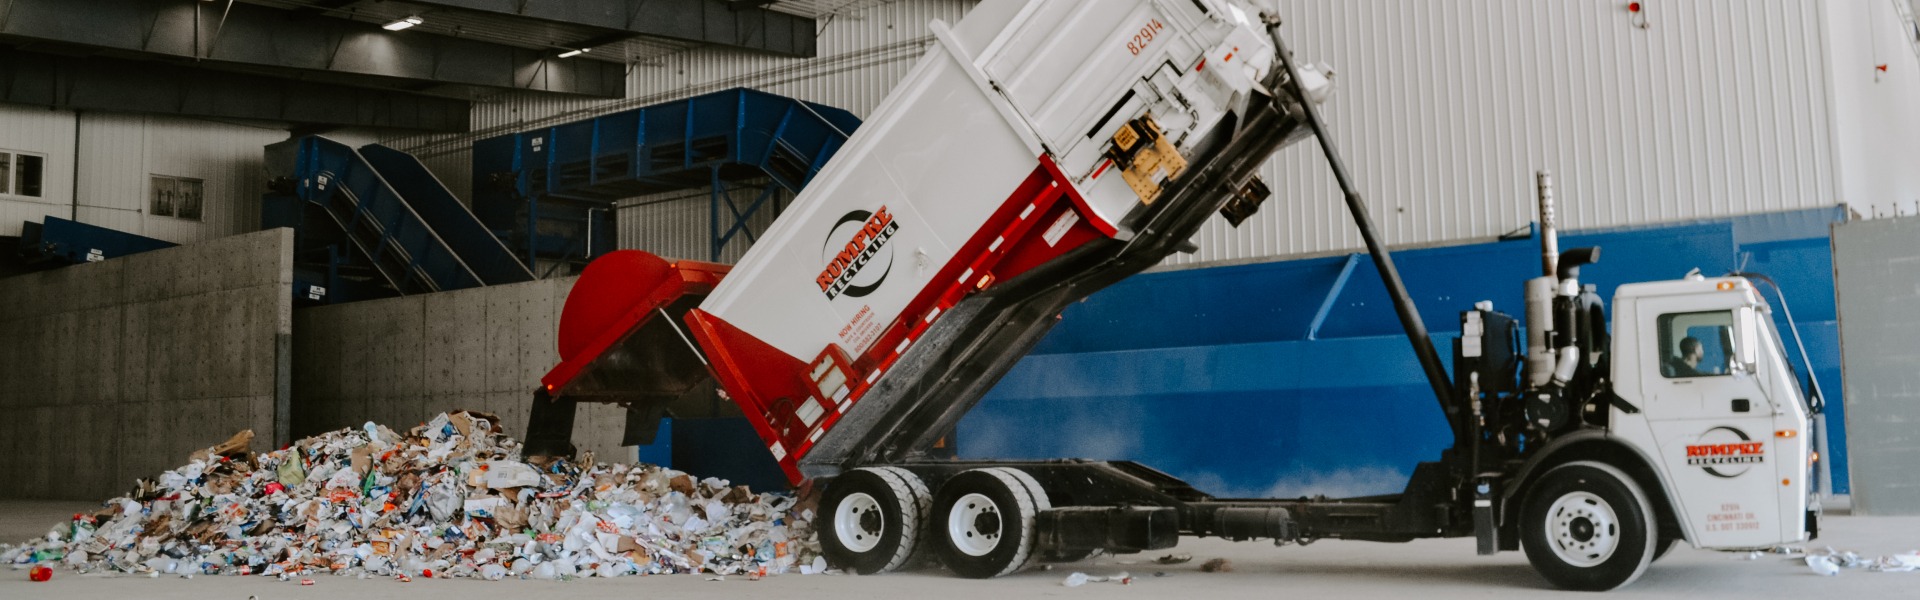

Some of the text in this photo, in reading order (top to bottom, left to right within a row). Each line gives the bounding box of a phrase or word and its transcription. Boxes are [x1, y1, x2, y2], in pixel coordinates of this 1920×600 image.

[1127, 18, 1163, 56] 82914
[816, 204, 893, 293] RUMPKE
[829, 225, 895, 297] RECYCLING
[838, 304, 870, 338] NOW HIRING
[1686, 442, 1764, 456] RUMPKE
